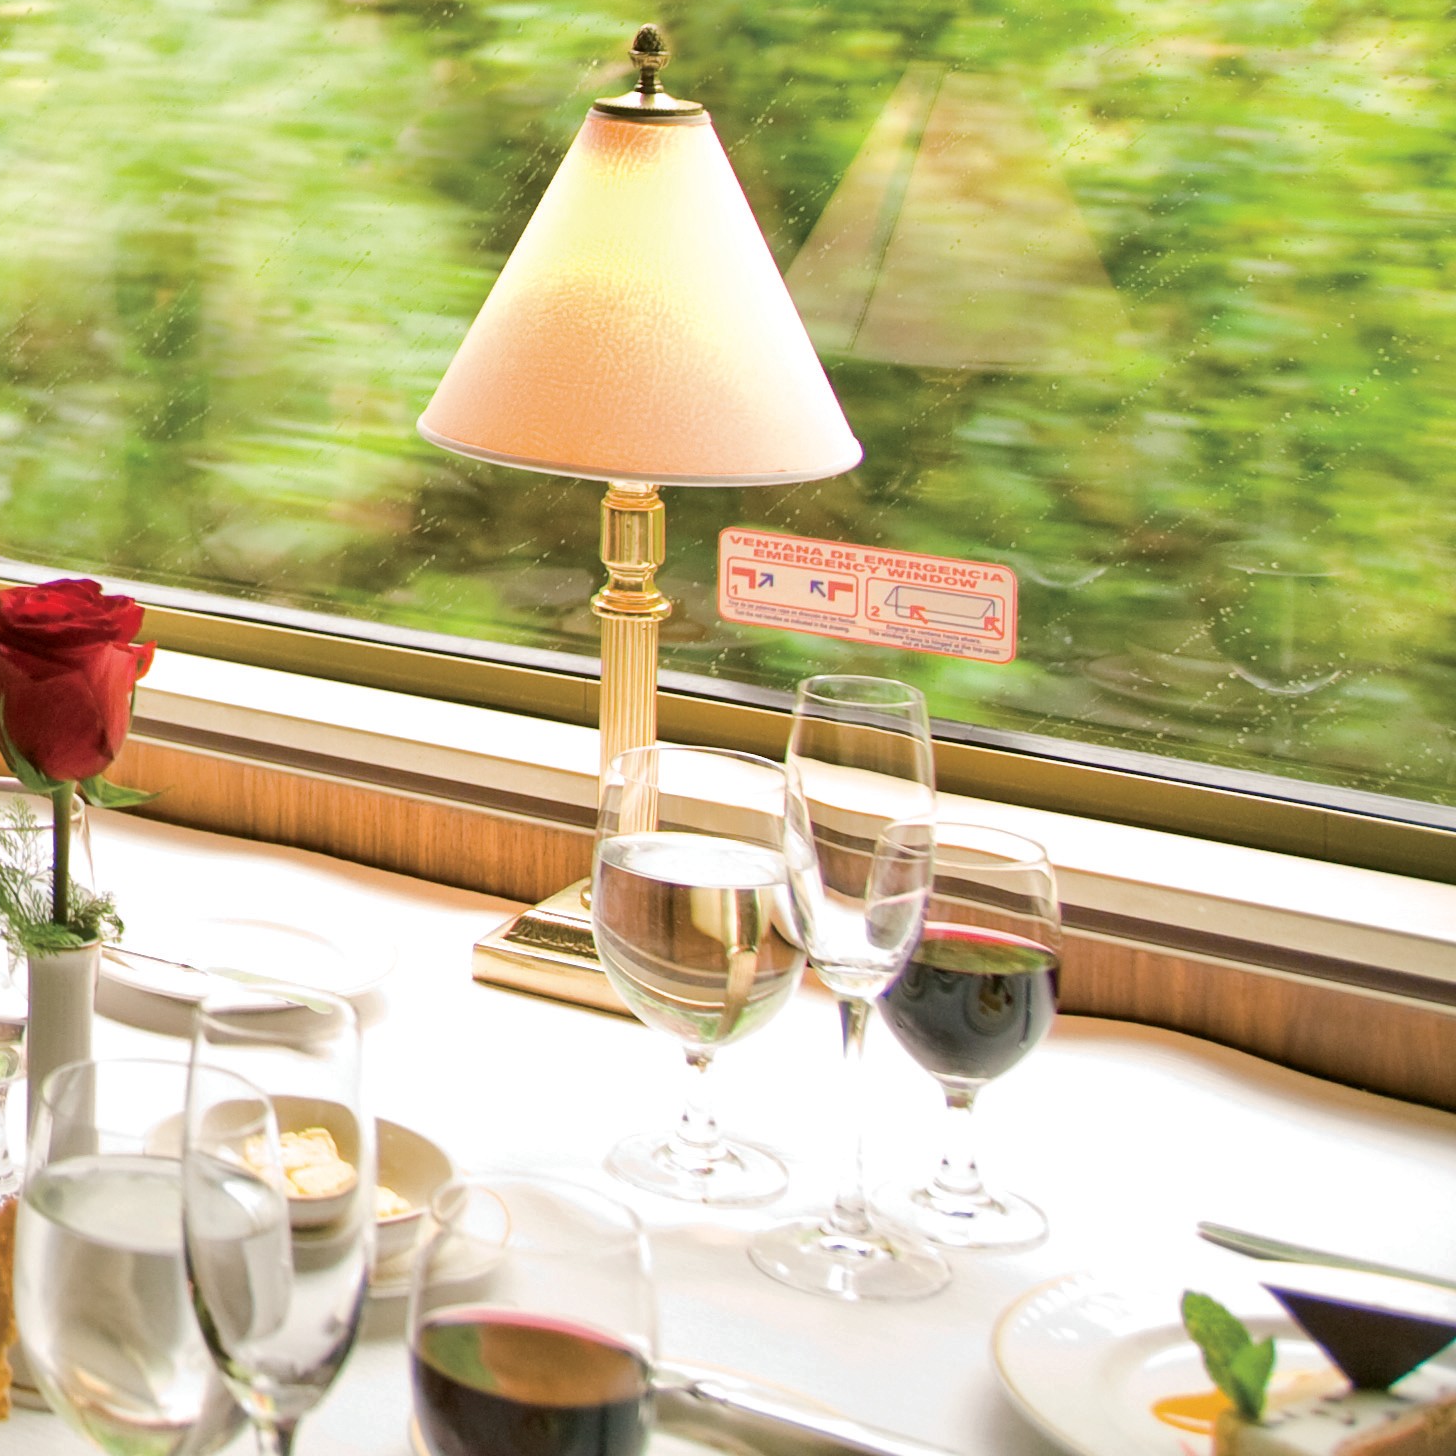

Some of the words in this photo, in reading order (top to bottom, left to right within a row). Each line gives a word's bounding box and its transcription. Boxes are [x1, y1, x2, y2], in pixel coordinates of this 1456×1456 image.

[729, 535, 823, 556] VENTANA
[830, 550, 857, 562] DE
[863, 555, 1004, 583] EMERGENCIA
[753, 549, 880, 574] EMERGENCY
[886, 568, 978, 589] WINDOW
[731, 584, 738, 595] 1
[870, 605, 880, 617] 2
